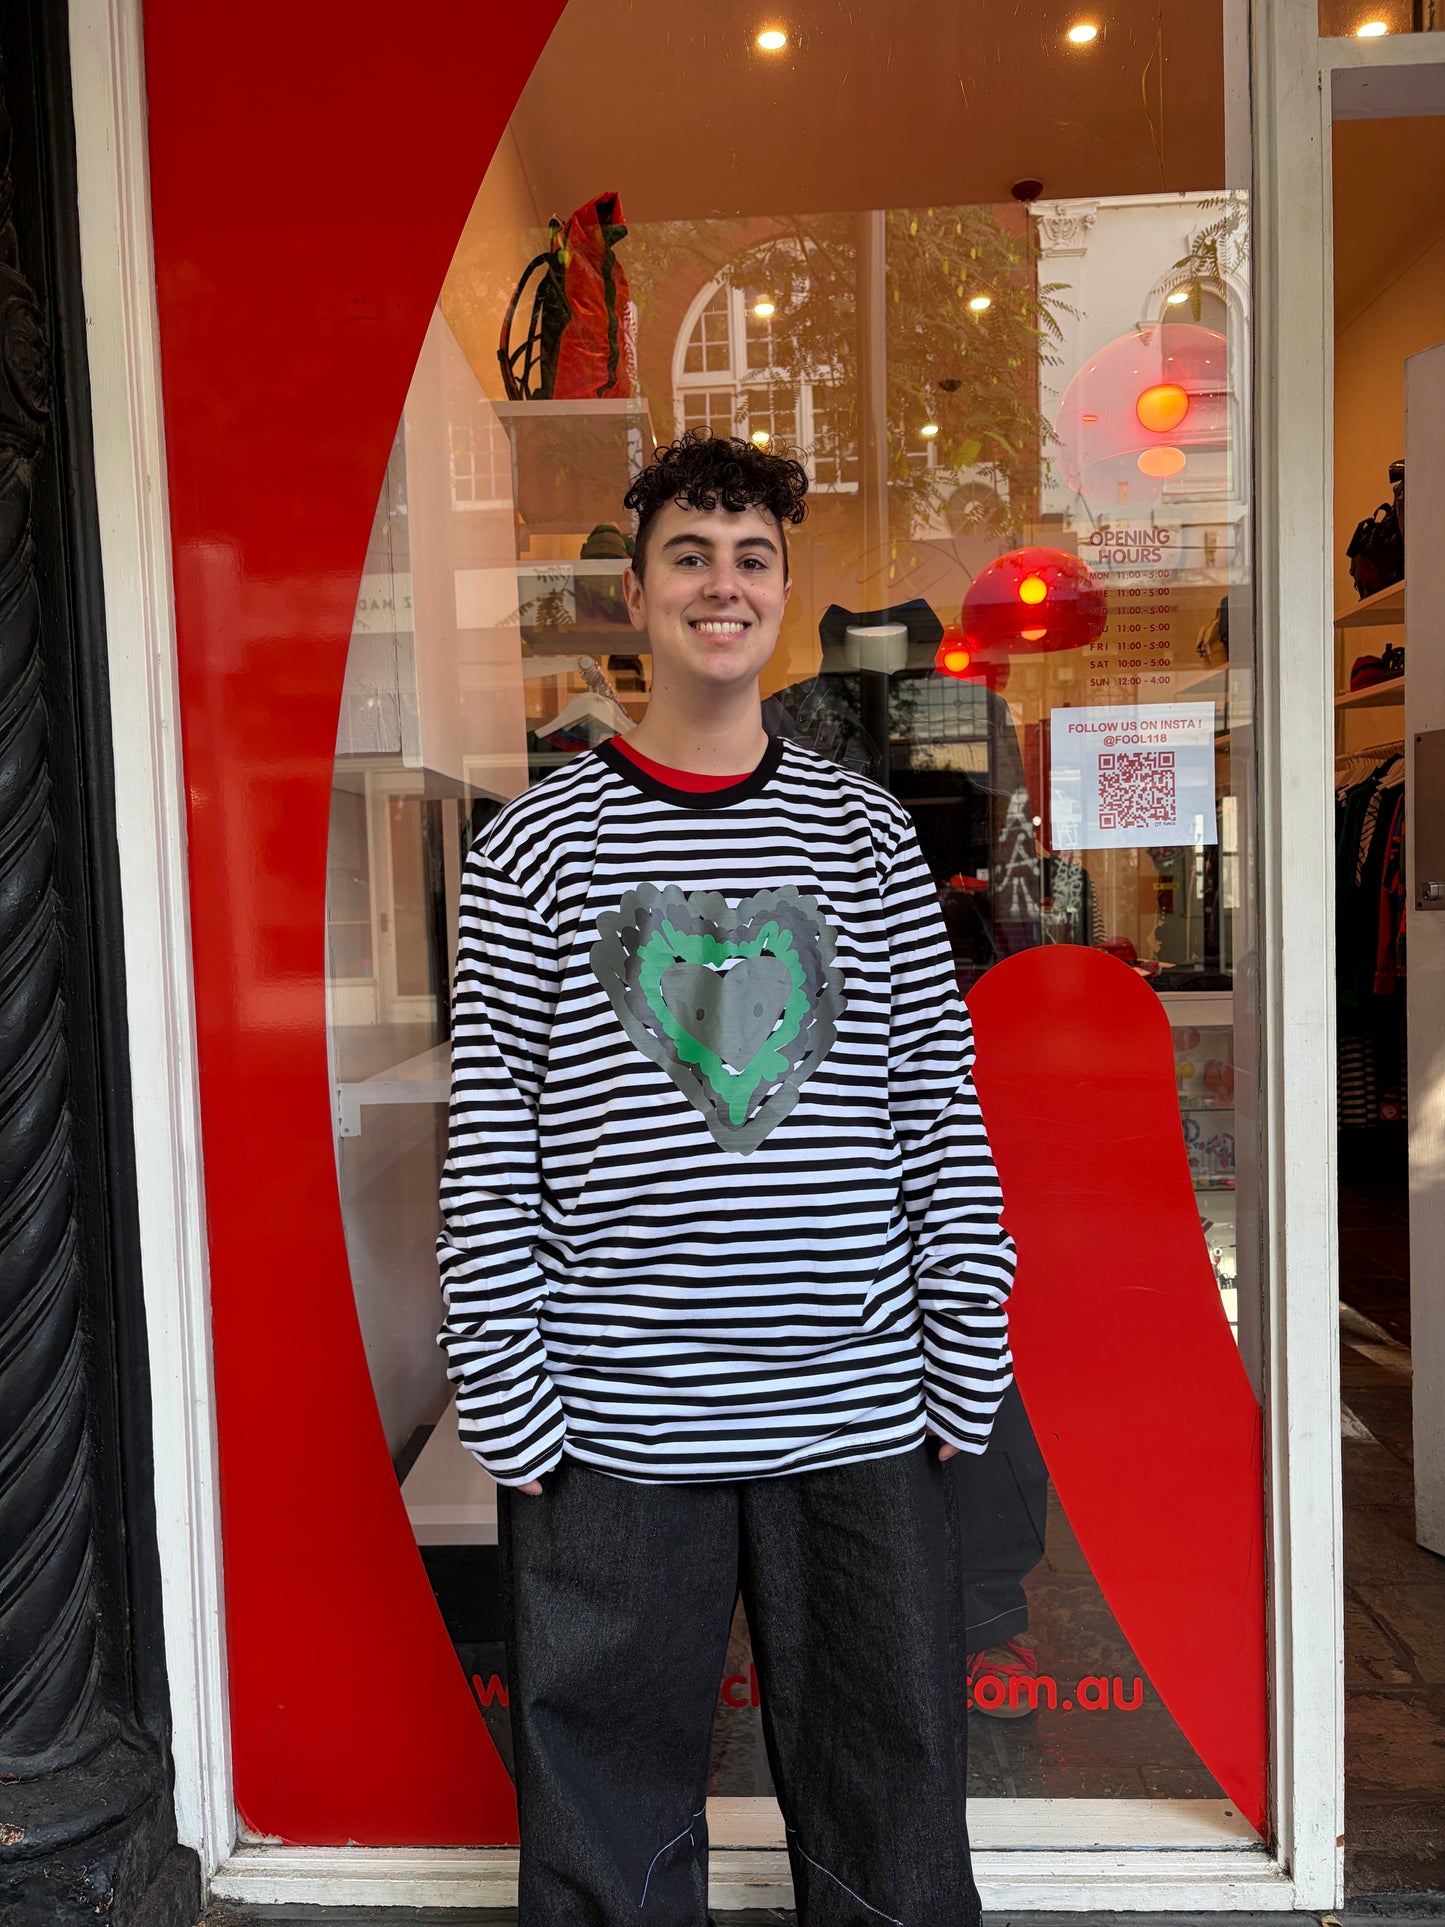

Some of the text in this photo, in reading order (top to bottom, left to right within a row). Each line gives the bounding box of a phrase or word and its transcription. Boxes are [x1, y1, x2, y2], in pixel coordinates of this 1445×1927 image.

[1089, 529, 1170, 546] OPENING
[1098, 546, 1162, 564] HOURS
[1089, 571, 1109, 580] MON
[1117, 570, 1140, 579] 11:00
[1149, 570, 1170, 579] 5:00
[1089, 589, 1109, 598] TUE
[1117, 588, 1140, 597] 11:00
[1149, 588, 1170, 597] 5:00
[1117, 606, 1140, 615] 11:00
[1149, 605, 1170, 615] 5:00
[1117, 624, 1141, 632] 11:00
[1149, 623, 1170, 632] 5:00
[1090, 642, 1108, 651] FRI
[1117, 642, 1141, 650] 11:00
[1149, 640, 1170, 649] 5:00
[1090, 660, 1109, 669] SAT
[1117, 659, 1141, 668] 10:00
[1150, 658, 1170, 667] 5:00
[1090, 678, 1109, 687] SUN
[1117, 677, 1141, 686] 12:00
[1150, 676, 1170, 684] 4:00
[1068, 722, 1118, 734] FOLLOW
[1121, 721, 1137, 732] US
[1140, 720, 1157, 730] ON
[1160, 719, 1195, 730] INSTA
[1103, 734, 1167, 747] @FOOL118
[967, 1676, 1143, 1711] om.au
